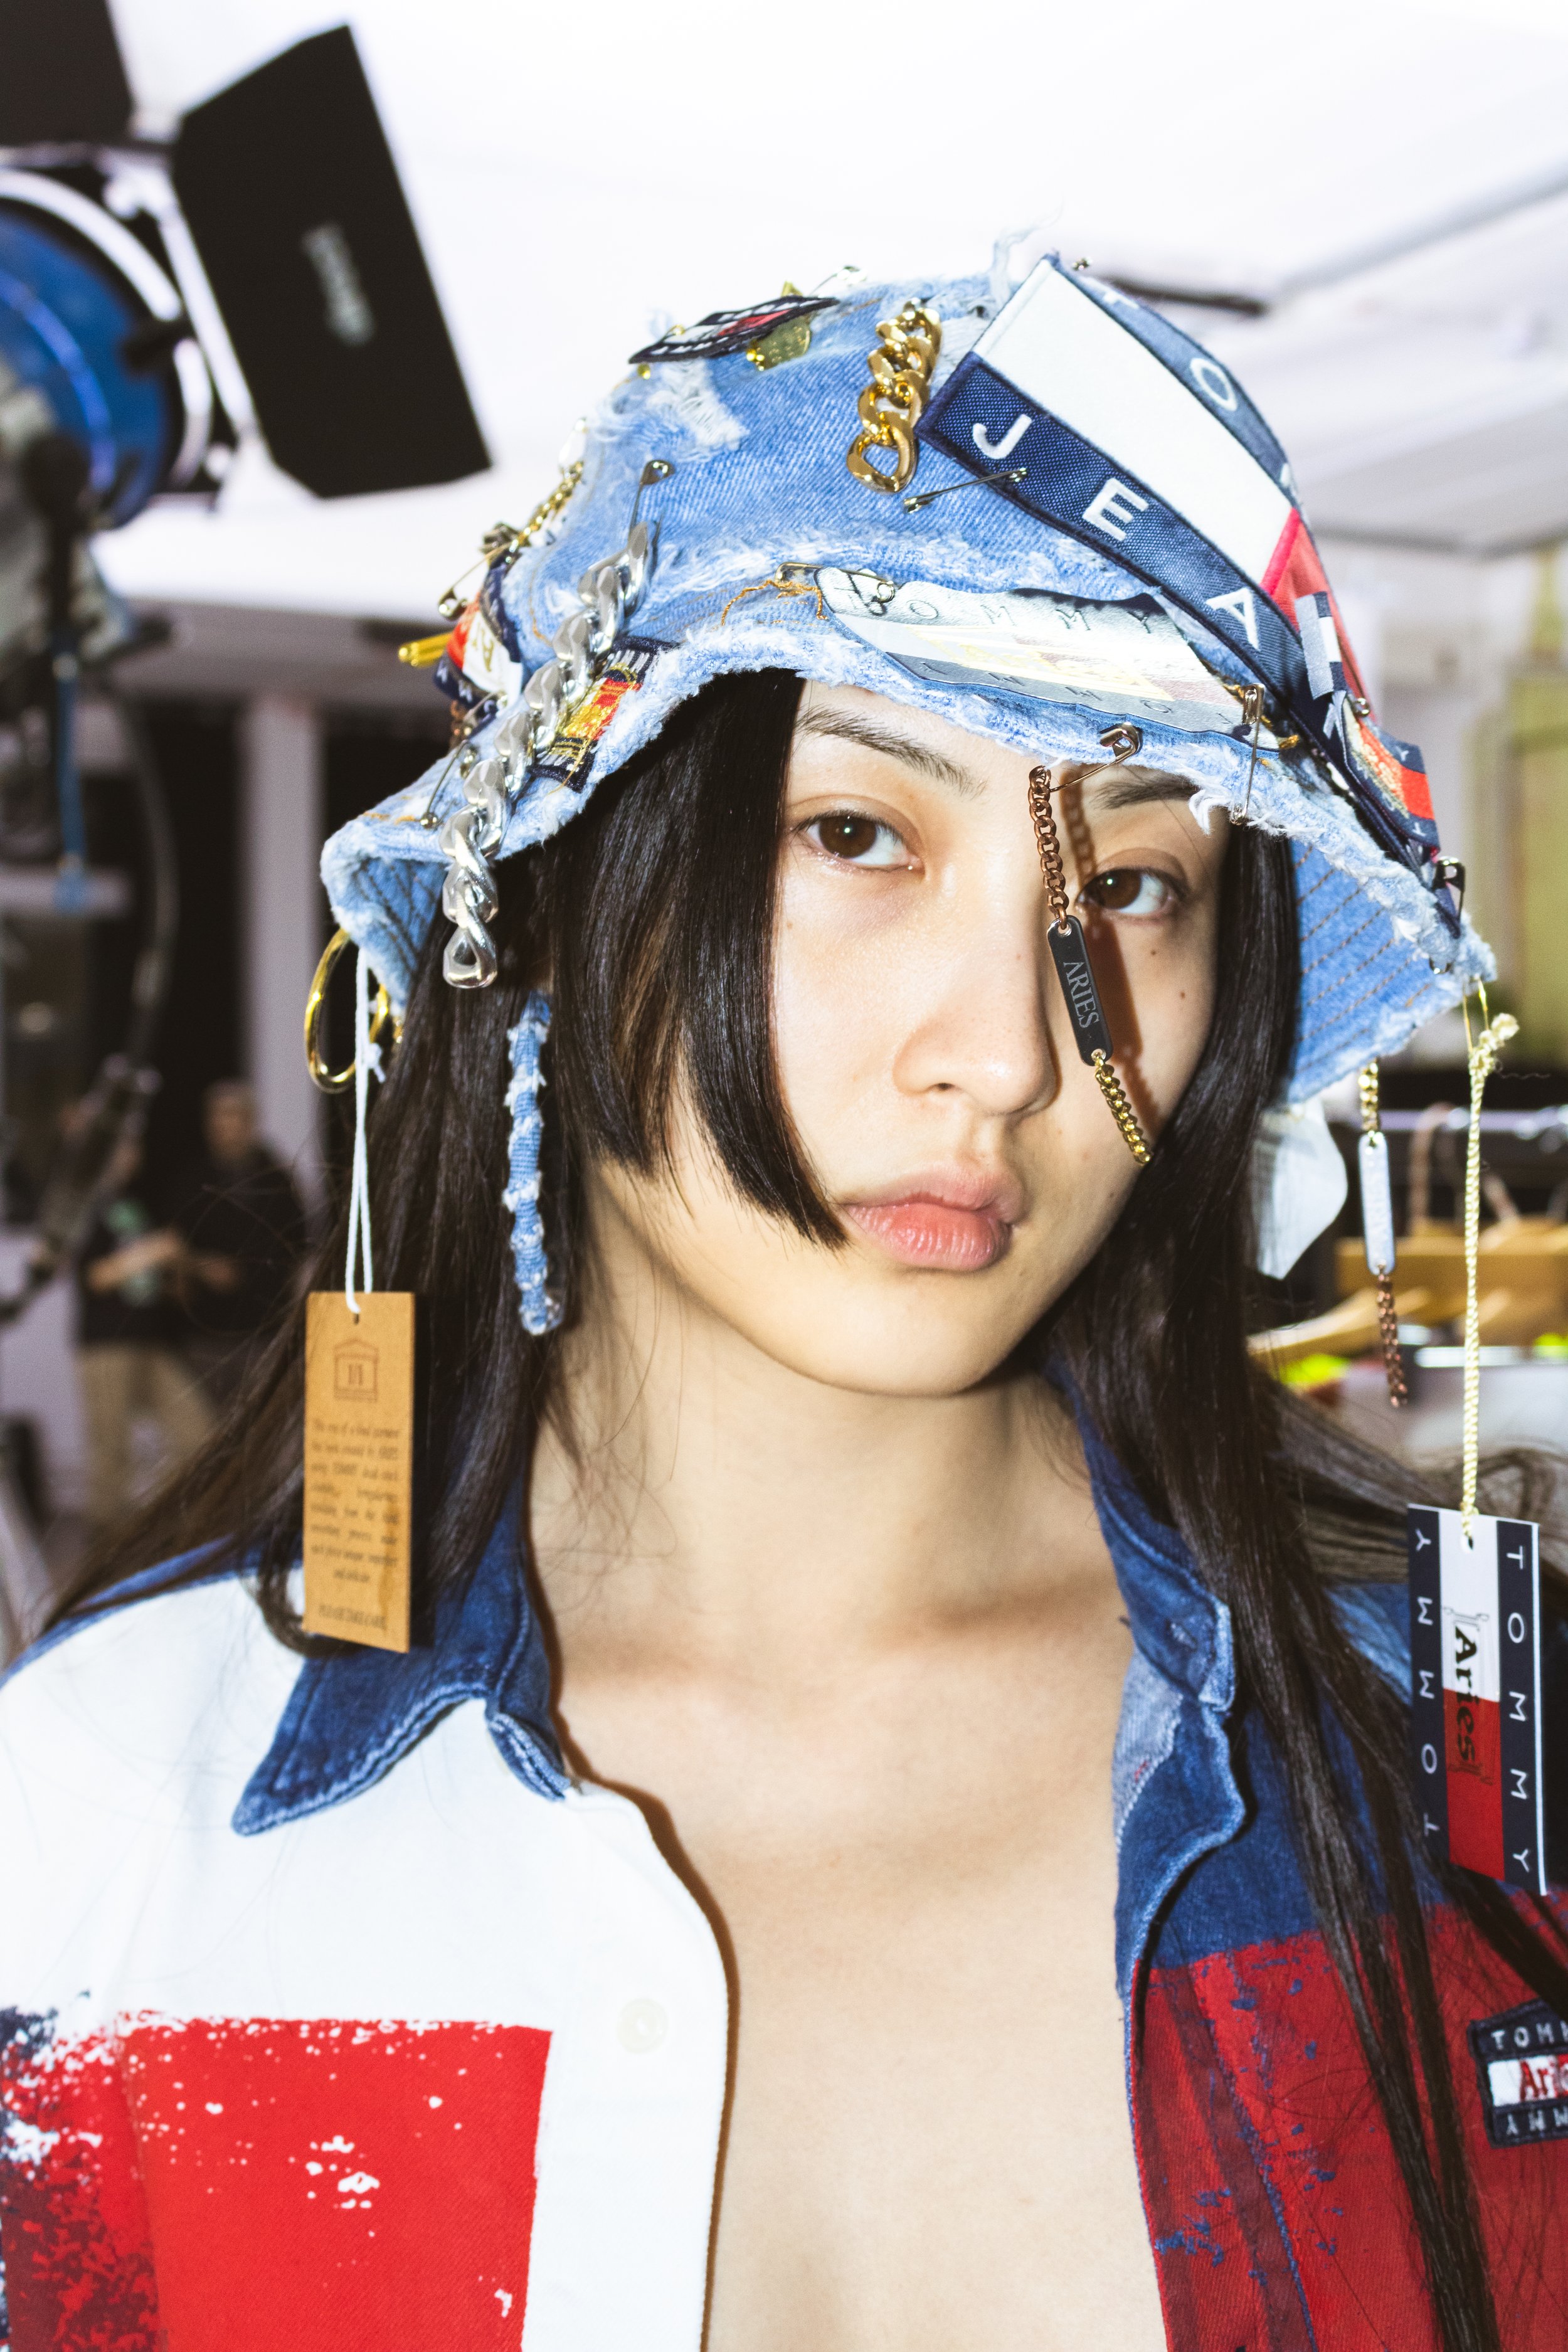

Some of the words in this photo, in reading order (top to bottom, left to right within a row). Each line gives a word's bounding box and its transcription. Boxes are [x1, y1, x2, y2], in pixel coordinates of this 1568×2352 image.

[1062, 961, 1101, 1029] ARIES
[1415, 1528, 1441, 1838] TOMMY
[1454, 1625, 1480, 1762] Aries
[1506, 1545, 1531, 1873] TOMMY
